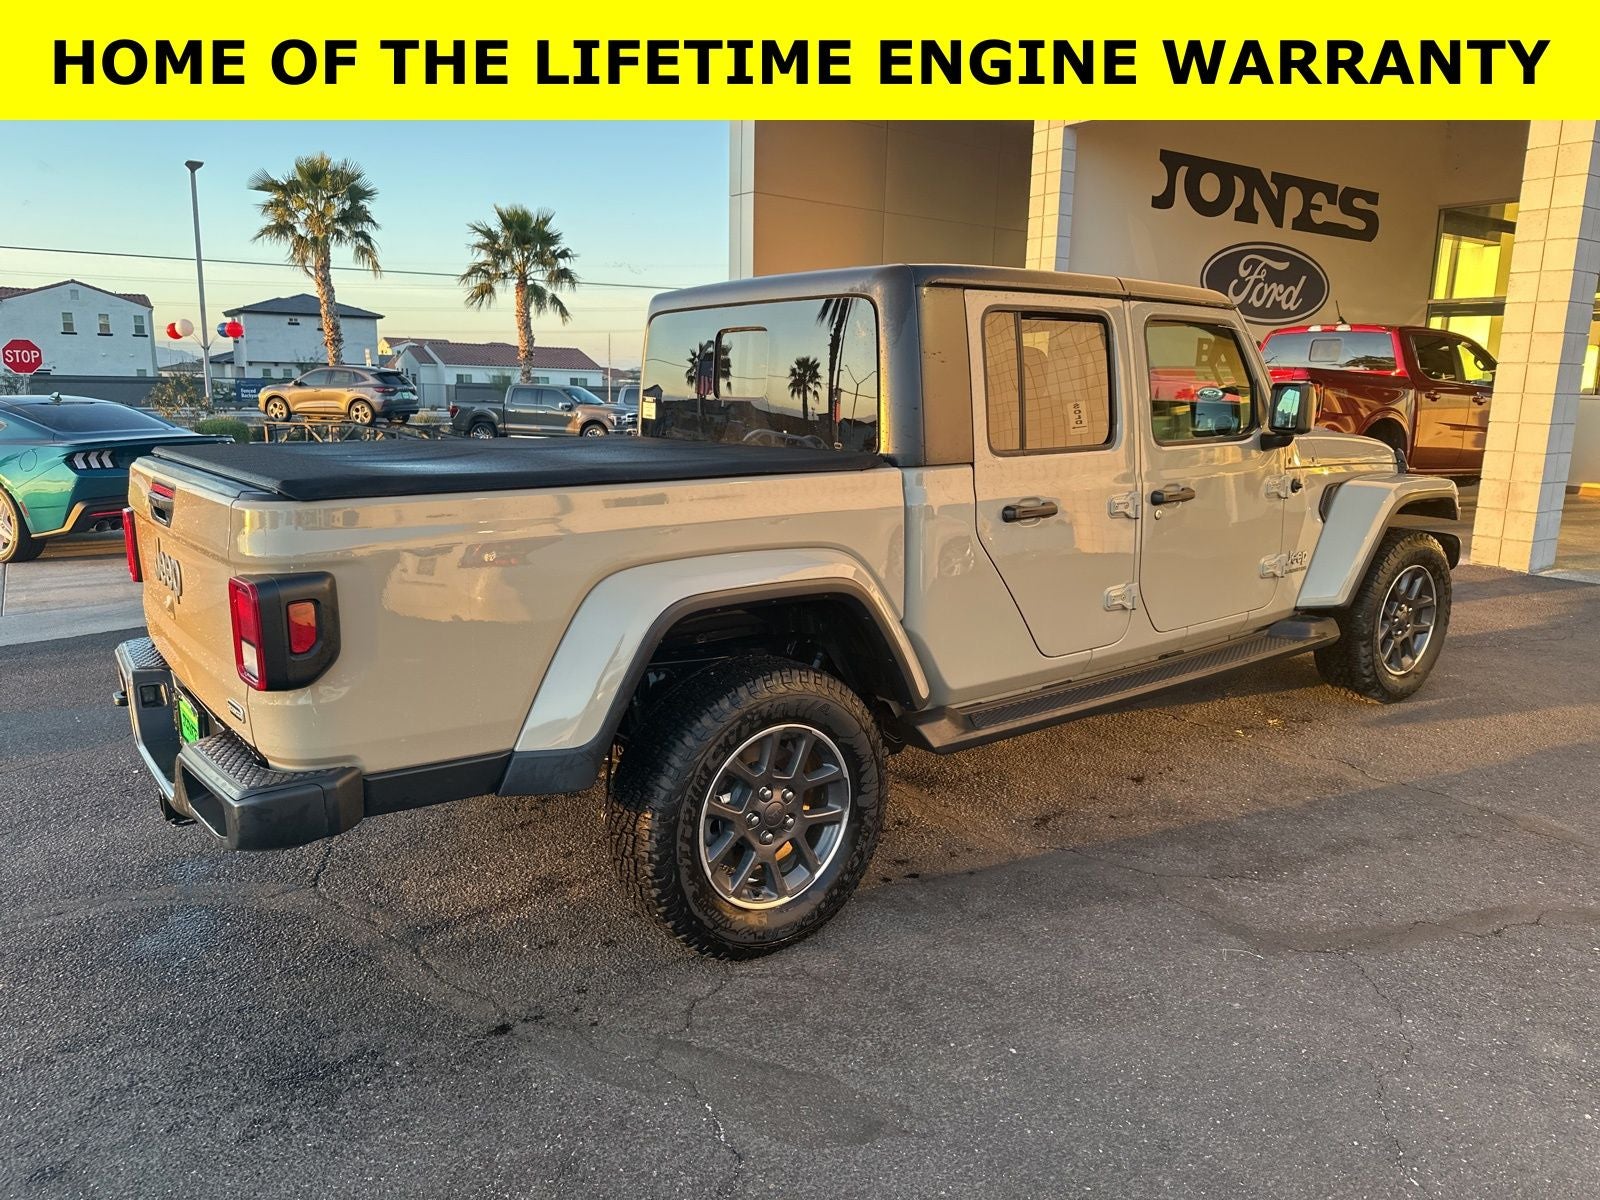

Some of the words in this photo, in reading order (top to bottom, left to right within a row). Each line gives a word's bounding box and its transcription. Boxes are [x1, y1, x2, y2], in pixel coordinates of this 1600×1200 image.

[1151, 148, 1379, 242] JONES
[1228, 253, 1307, 311] Ford
[4, 349, 40, 363] STOP
[154, 536, 183, 605] Jeep
